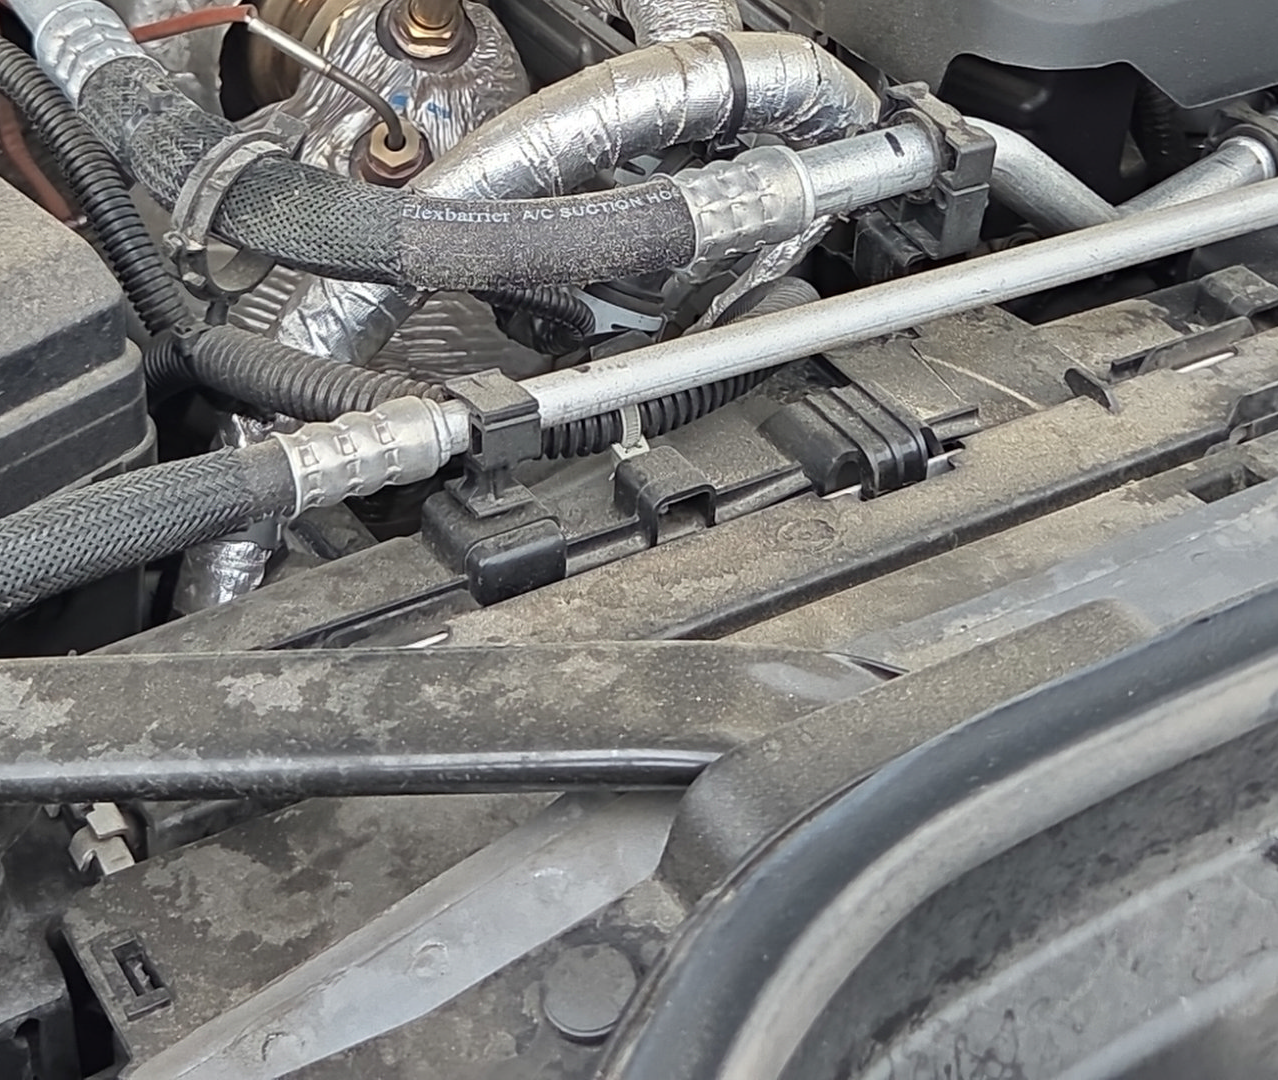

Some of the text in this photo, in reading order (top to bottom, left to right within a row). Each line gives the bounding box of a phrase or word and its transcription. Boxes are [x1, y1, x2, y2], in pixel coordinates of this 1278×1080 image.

[402, 203, 511, 223] Flexbarrier
[522, 207, 555, 221] A/C
[560, 196, 643, 219] SUCTION
